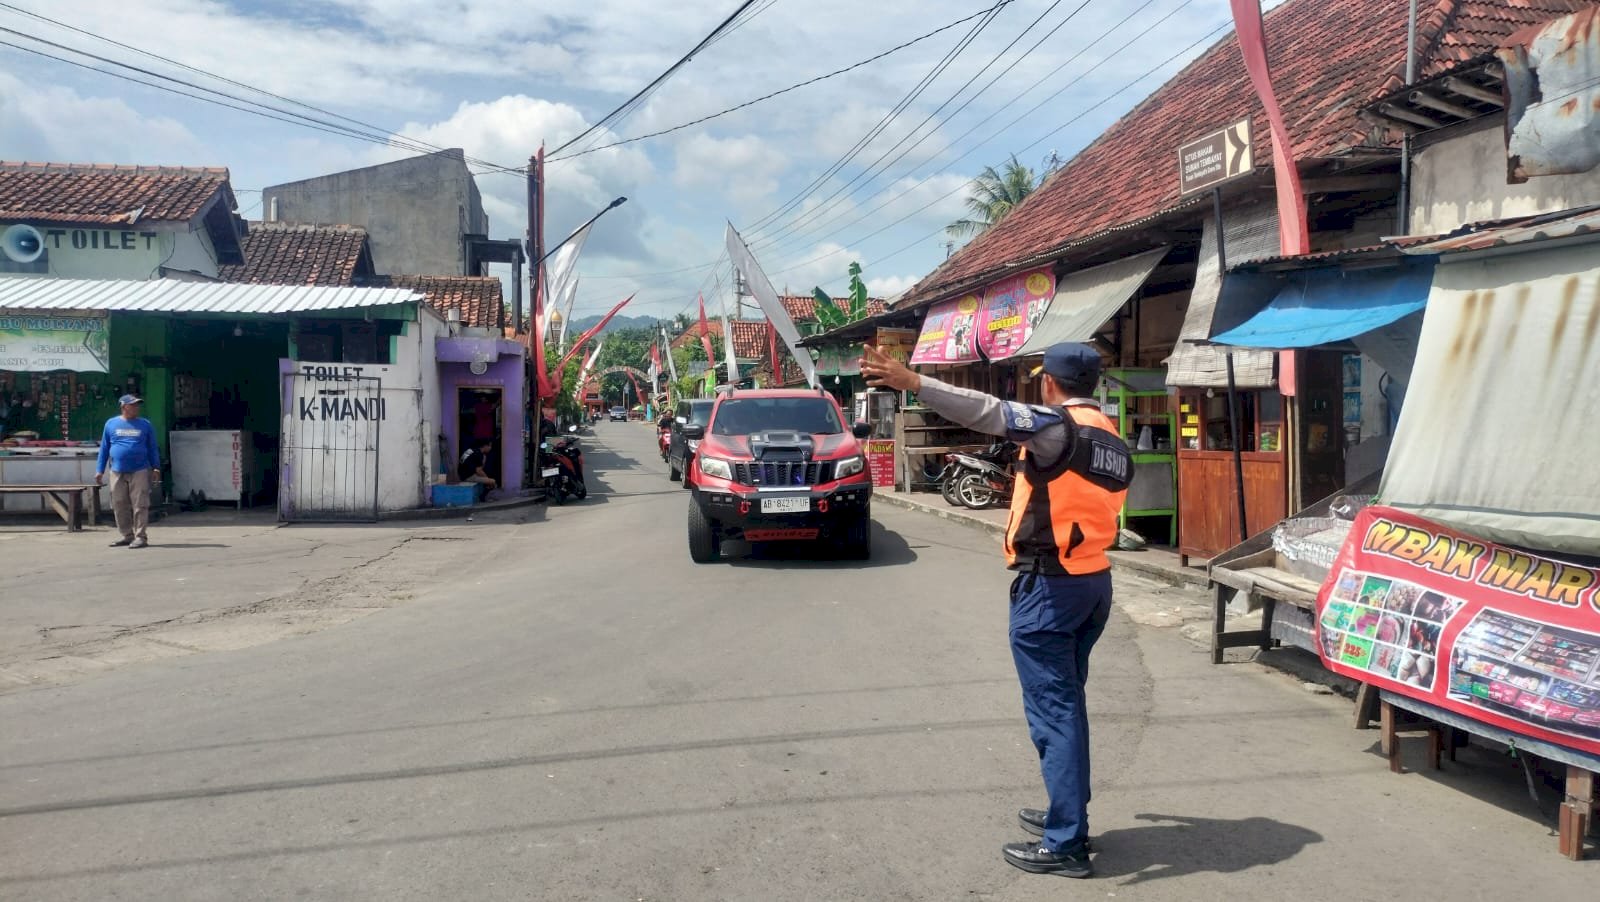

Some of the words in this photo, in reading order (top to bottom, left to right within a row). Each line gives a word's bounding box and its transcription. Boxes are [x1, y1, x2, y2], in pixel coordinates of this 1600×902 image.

[47, 229, 156, 250] TOILET
[25, 318, 102, 331] MULYANI
[302, 366, 363, 381] TOILET
[1093, 446, 1128, 478] DISHUB
[763, 500, 772, 509] AB
[1363, 519, 1485, 579] MBAK
[1478, 549, 1594, 605] MAR
